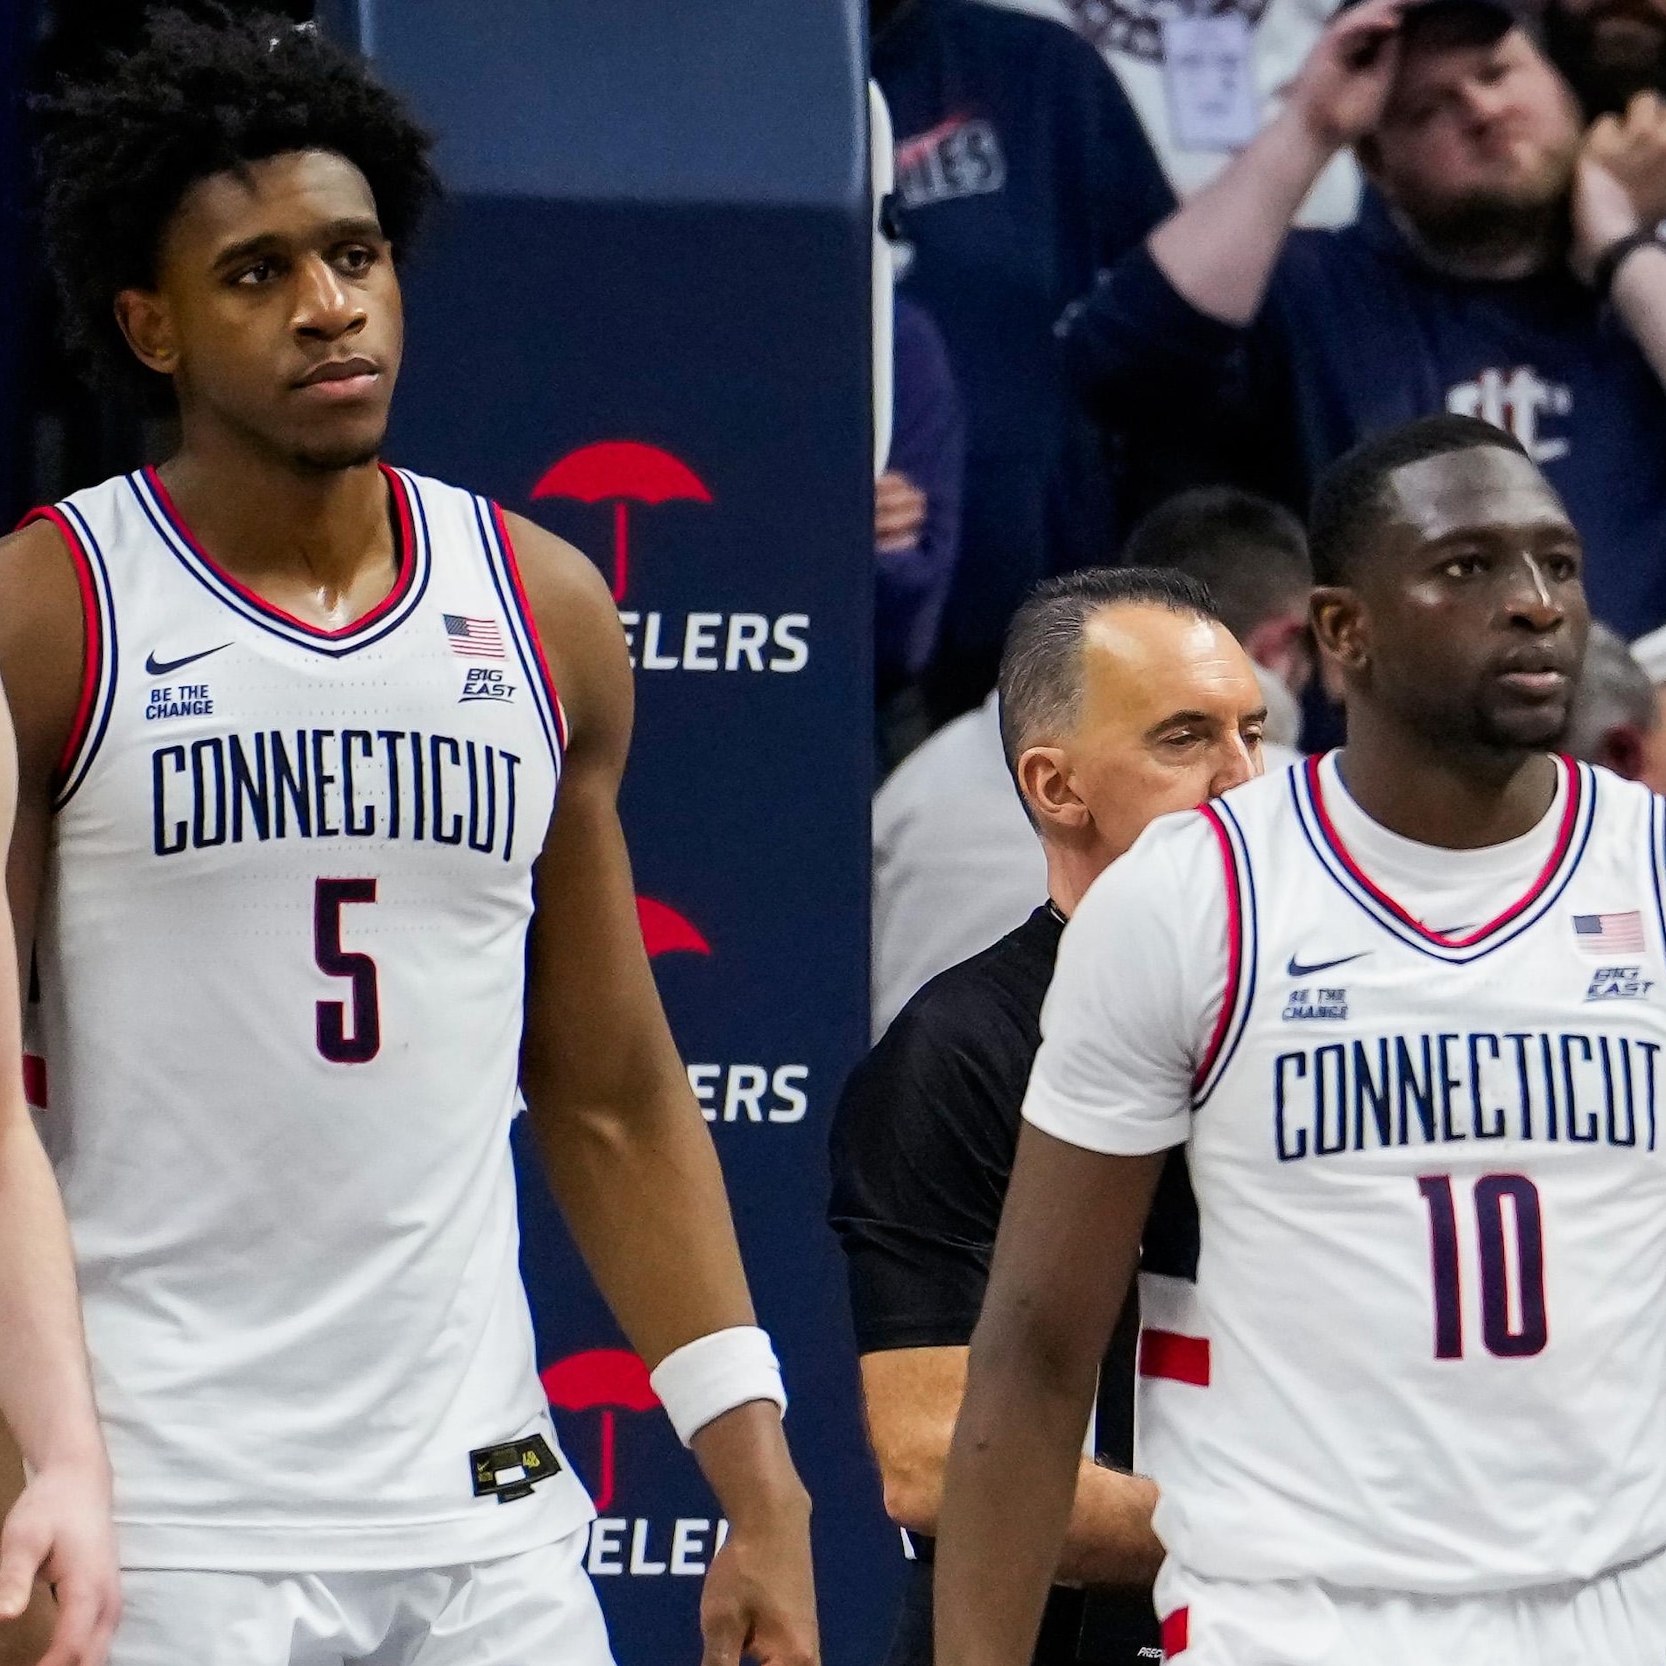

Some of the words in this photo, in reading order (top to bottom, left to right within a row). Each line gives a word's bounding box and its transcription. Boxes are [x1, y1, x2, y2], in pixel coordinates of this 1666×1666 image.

[145, 699, 214, 721] CHANGE
[151, 687, 173, 704] BE
[178, 684, 209, 701] THE
[462, 682, 517, 698] EAST
[466, 668, 503, 682] BIG
[151, 729, 522, 862] CONNECTICUT
[314, 878, 381, 1064] 5
[1273, 1032, 1662, 1162] CONNECTICUT
[1416, 1173, 1549, 1361] 10
